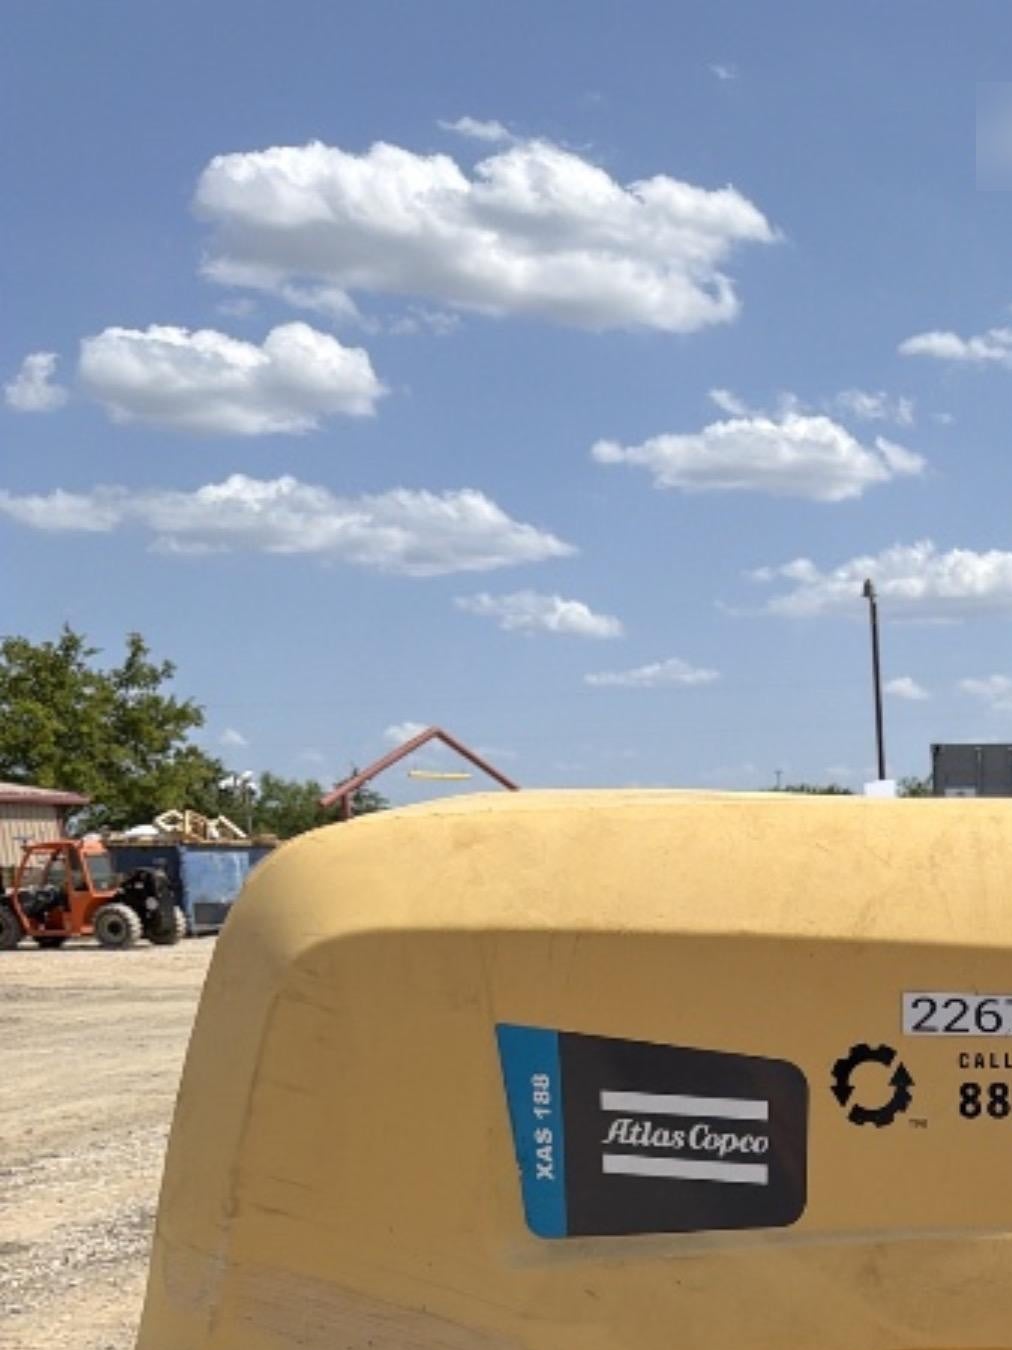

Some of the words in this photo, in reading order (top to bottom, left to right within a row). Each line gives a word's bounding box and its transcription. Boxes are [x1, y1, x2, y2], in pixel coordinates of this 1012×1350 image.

[534, 1128, 555, 1181] XAS
[601, 1118, 686, 1149] Atlas
[688, 1123, 769, 1158] Copco
